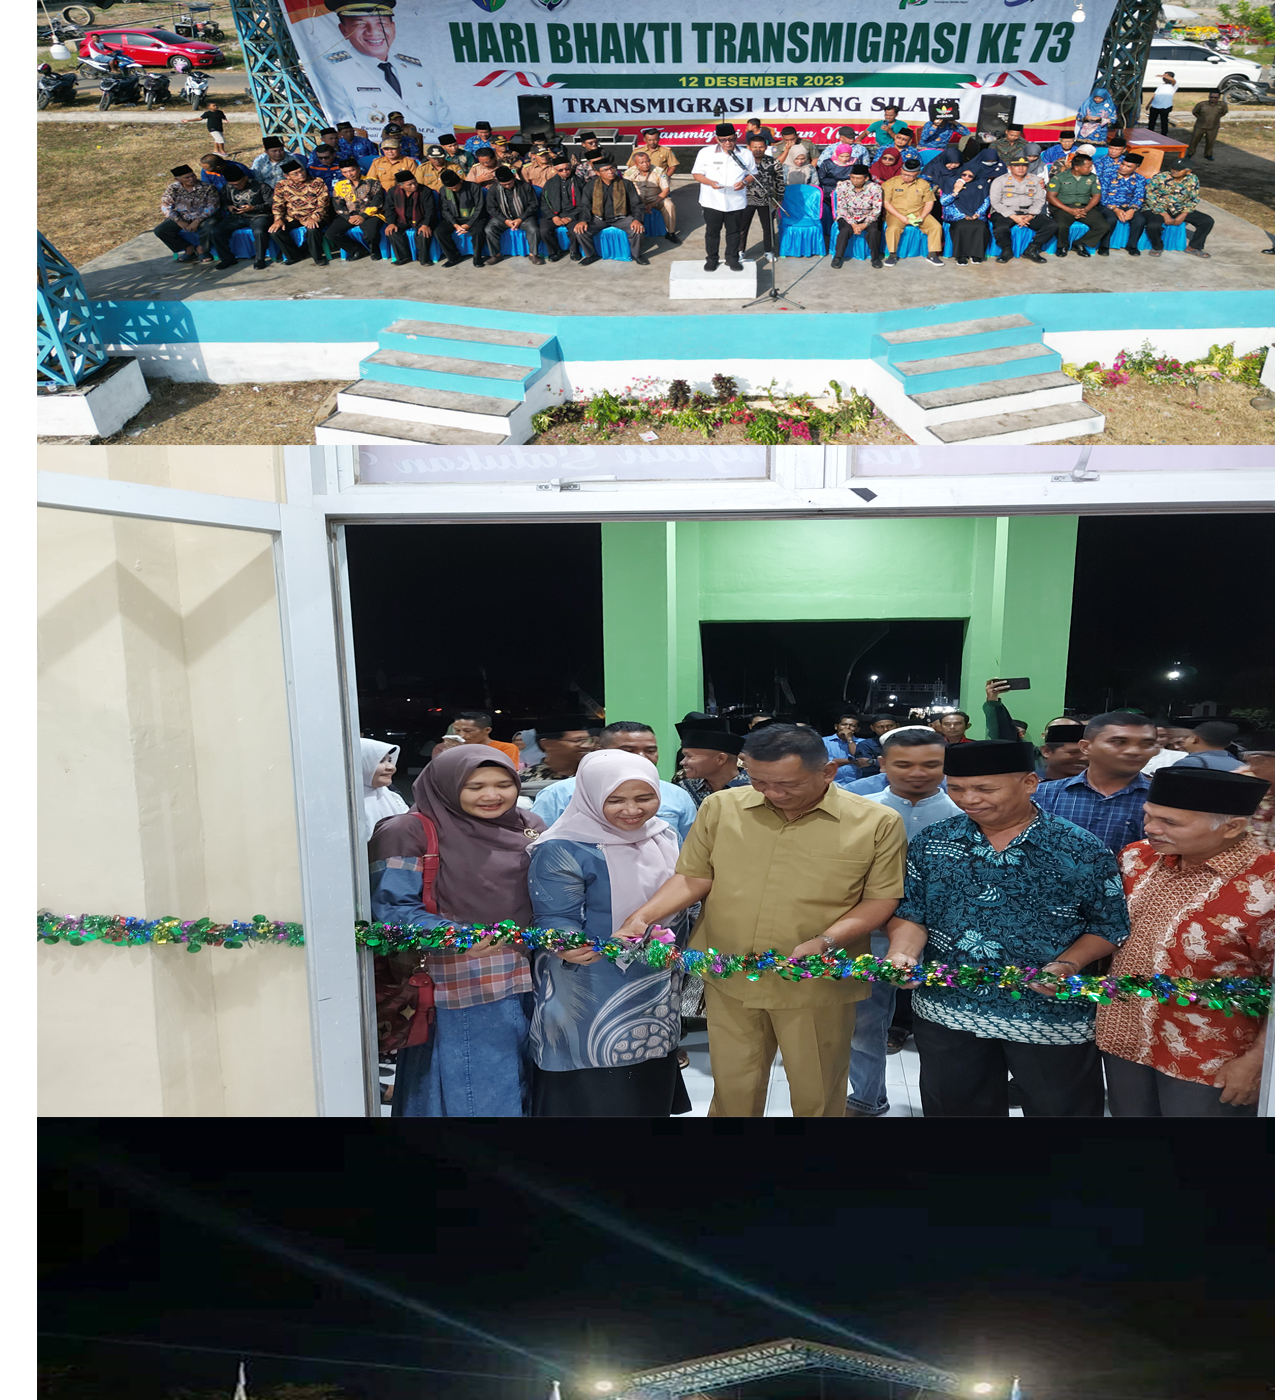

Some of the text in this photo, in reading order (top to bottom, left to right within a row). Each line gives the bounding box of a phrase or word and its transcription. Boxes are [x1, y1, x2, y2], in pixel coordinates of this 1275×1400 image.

[449, 22, 1075, 64] HARI BHAKTI TRANSMIGRASI KE 73
[679, 76, 845, 88] 12 DESEMBER 2023
[562, 97, 754, 114] TRANSMIGRASI
[763, 96, 863, 113] LUNANG
